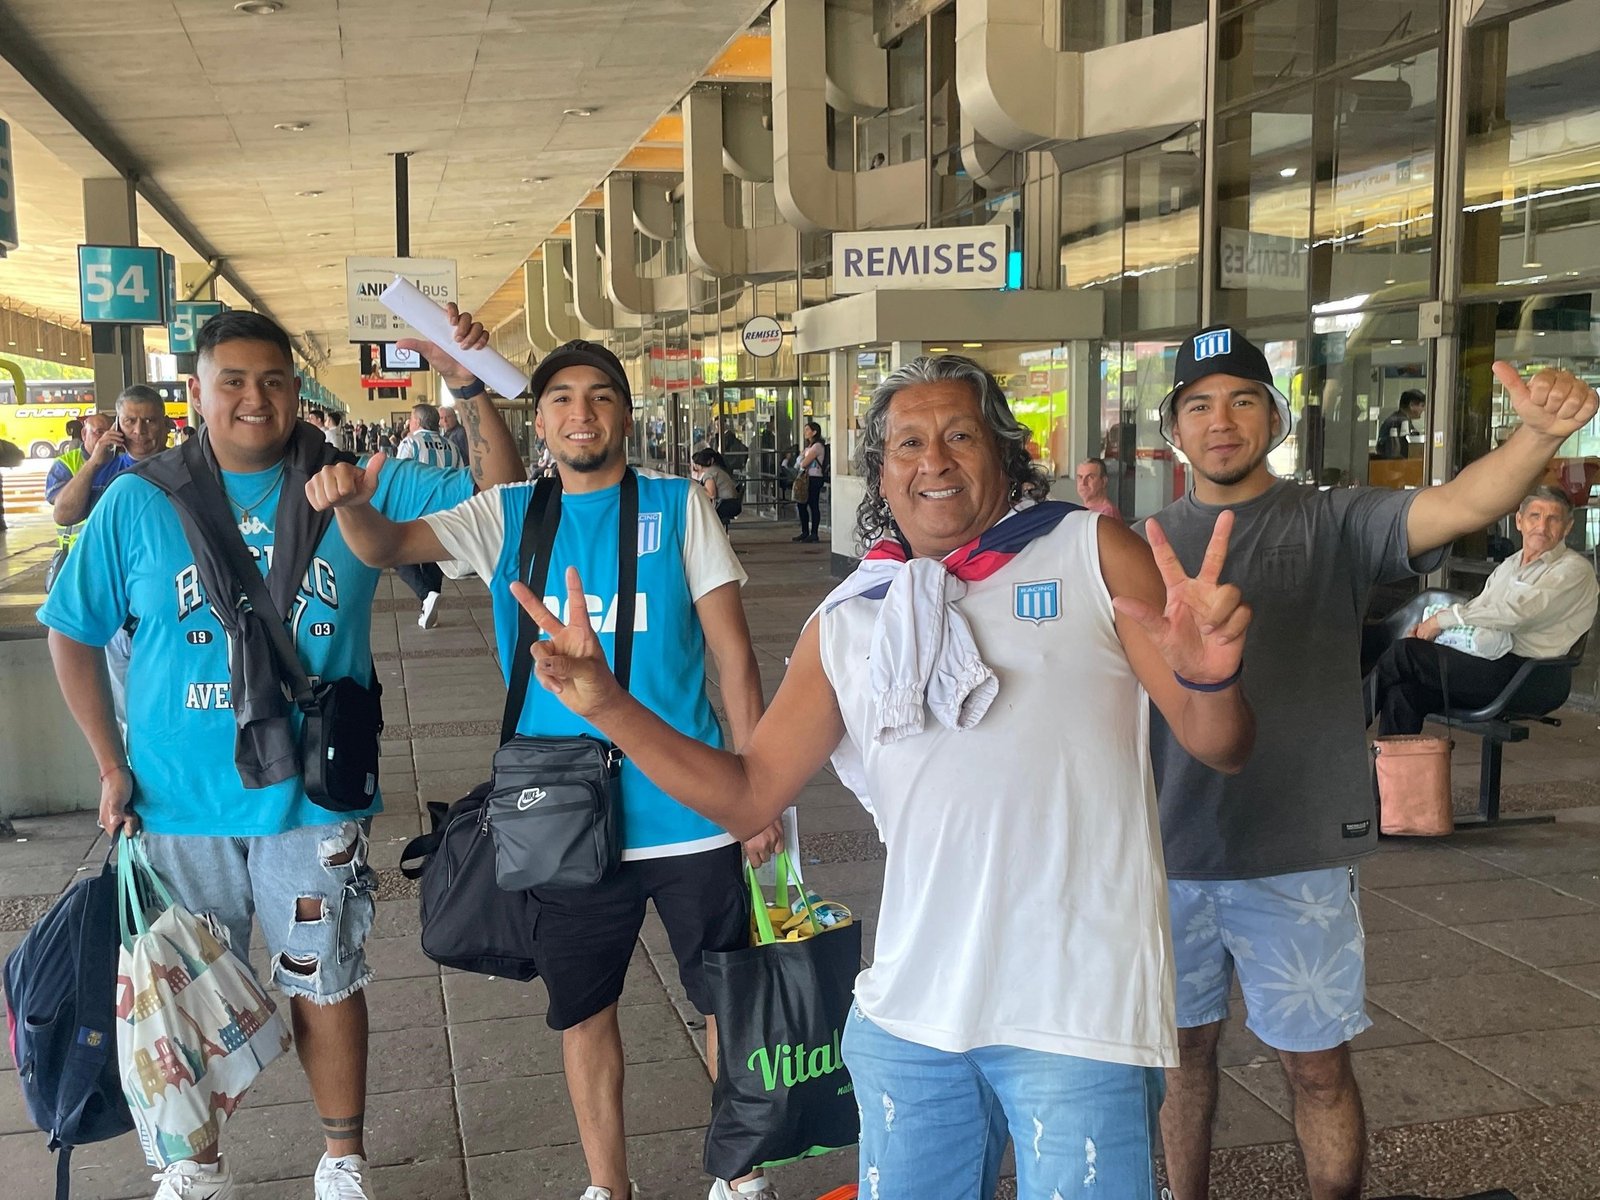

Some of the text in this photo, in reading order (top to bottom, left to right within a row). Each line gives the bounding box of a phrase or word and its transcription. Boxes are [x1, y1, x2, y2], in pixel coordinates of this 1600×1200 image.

[844, 241, 998, 277] REMISES
[86, 263, 150, 304] 54
[422, 285, 449, 297] BUS
[744, 329, 780, 341] REMISES
[1020, 585, 1054, 593] RACING
[314, 623, 331, 636] 03
[192, 631, 206, 643] 19
[747, 1027, 844, 1092] Vital
